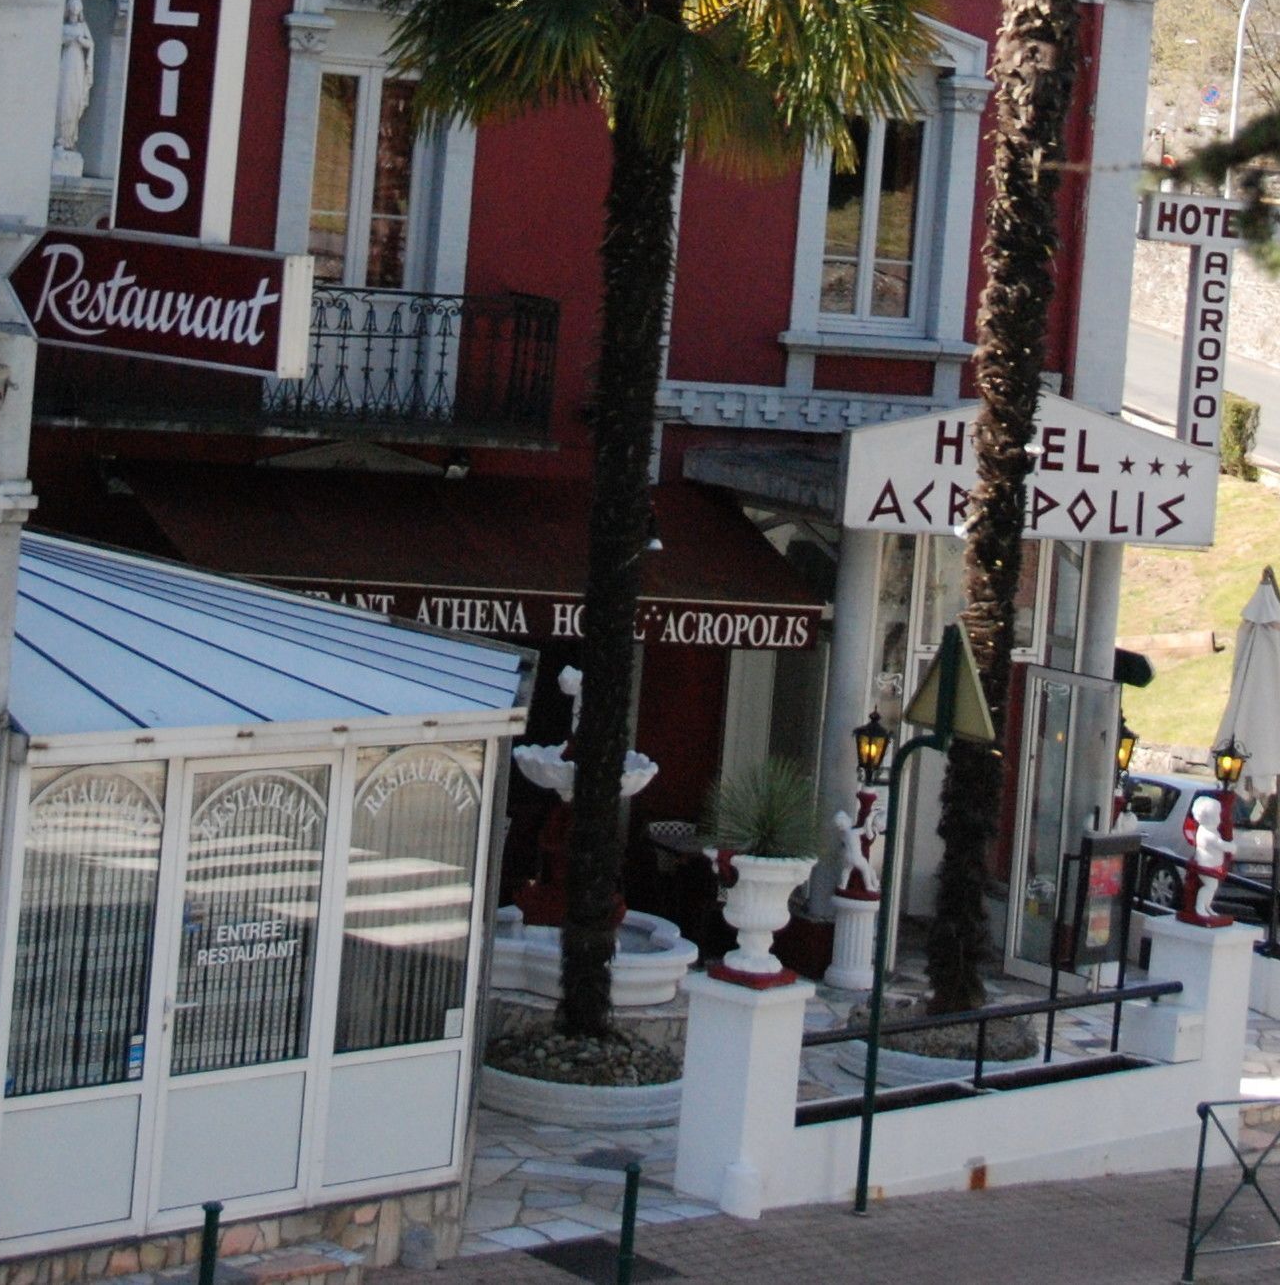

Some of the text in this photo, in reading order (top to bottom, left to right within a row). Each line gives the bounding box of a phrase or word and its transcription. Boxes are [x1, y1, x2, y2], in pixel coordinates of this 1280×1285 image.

[1157, 201, 1247, 240] HOTE
[33, 243, 280, 346] Restaurant
[1190, 251, 1229, 447] ACROPOL
[934, 420, 1100, 475] HEL
[867, 478, 1186, 538] ACRPOLIS
[416, 596, 529, 634] ATHENA
[660, 610, 809, 647] ACROPOLIS
[200, 782, 321, 839] RESTAURANT
[364, 757, 476, 815] RESTAURANT
[197, 939, 298, 966] RESTAURANT
